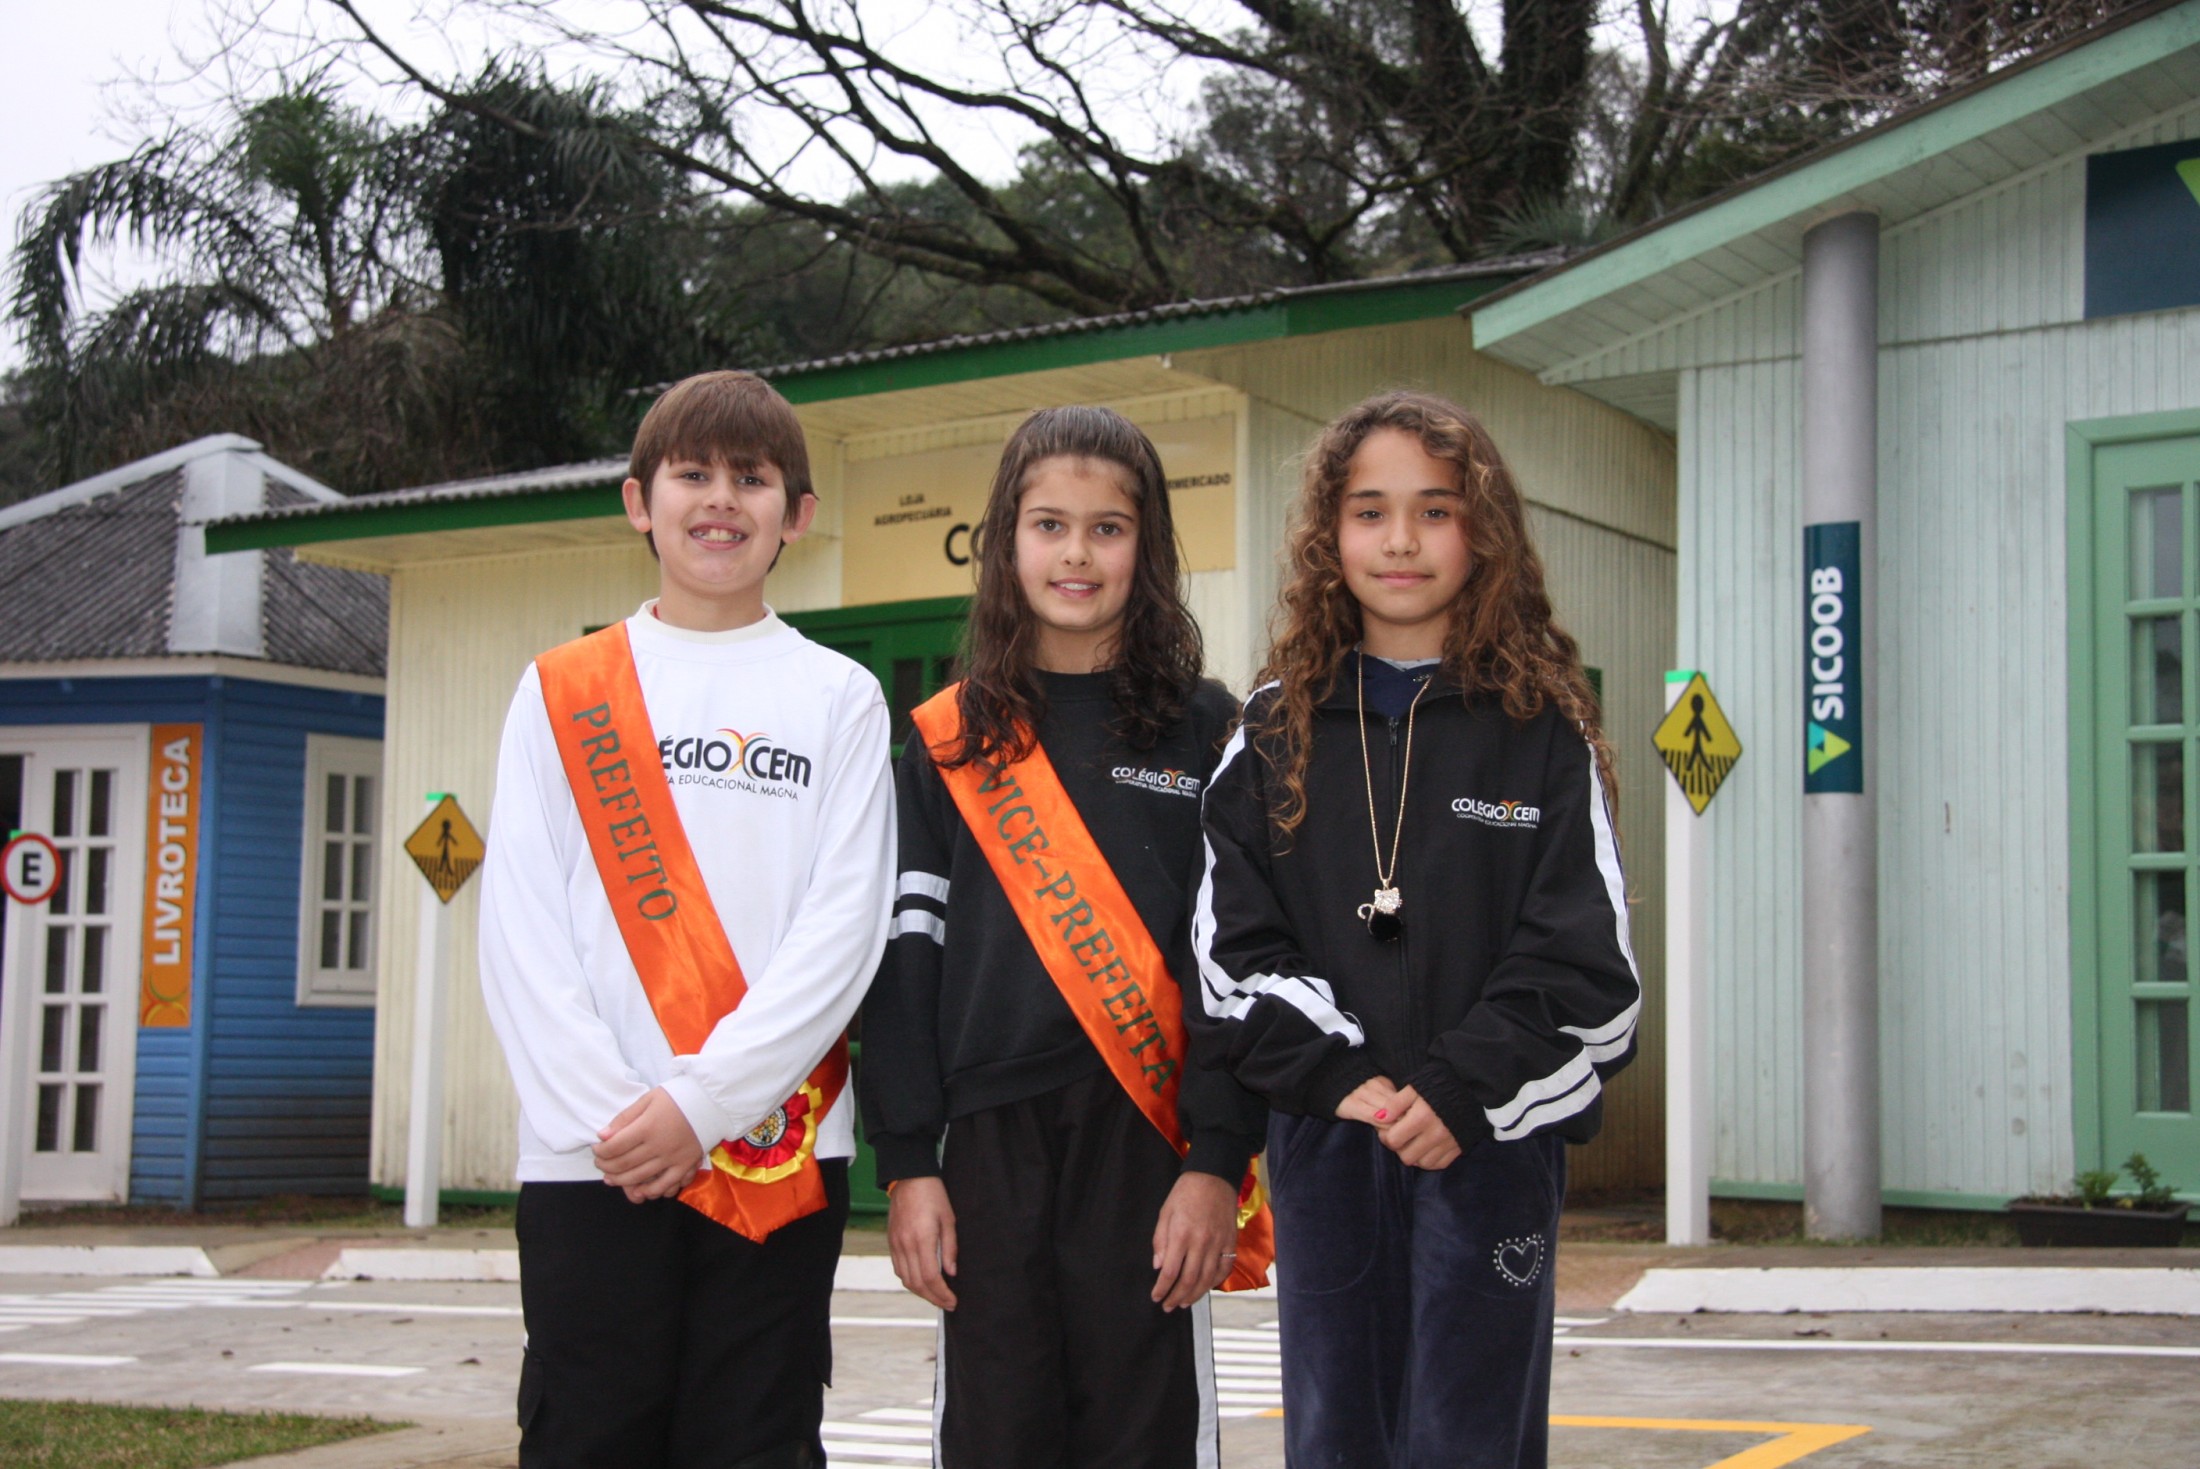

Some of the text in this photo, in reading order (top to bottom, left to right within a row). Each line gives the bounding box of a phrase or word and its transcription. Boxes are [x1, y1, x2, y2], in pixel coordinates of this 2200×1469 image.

[1811, 566, 1844, 721] SICOOB
[572, 702, 678, 920] PREFEITO
[658, 734, 812, 788] ÉGIO CEM
[678, 774, 757, 794] EDUCACIONAL
[759, 785, 799, 801] MAGNA
[1451, 797, 1541, 823] COLÉGIO CEM
[21, 853, 42, 887] E
[153, 736, 191, 965] LIVROTECA
[977, 760, 1179, 1095] VICE-PREFEITA
